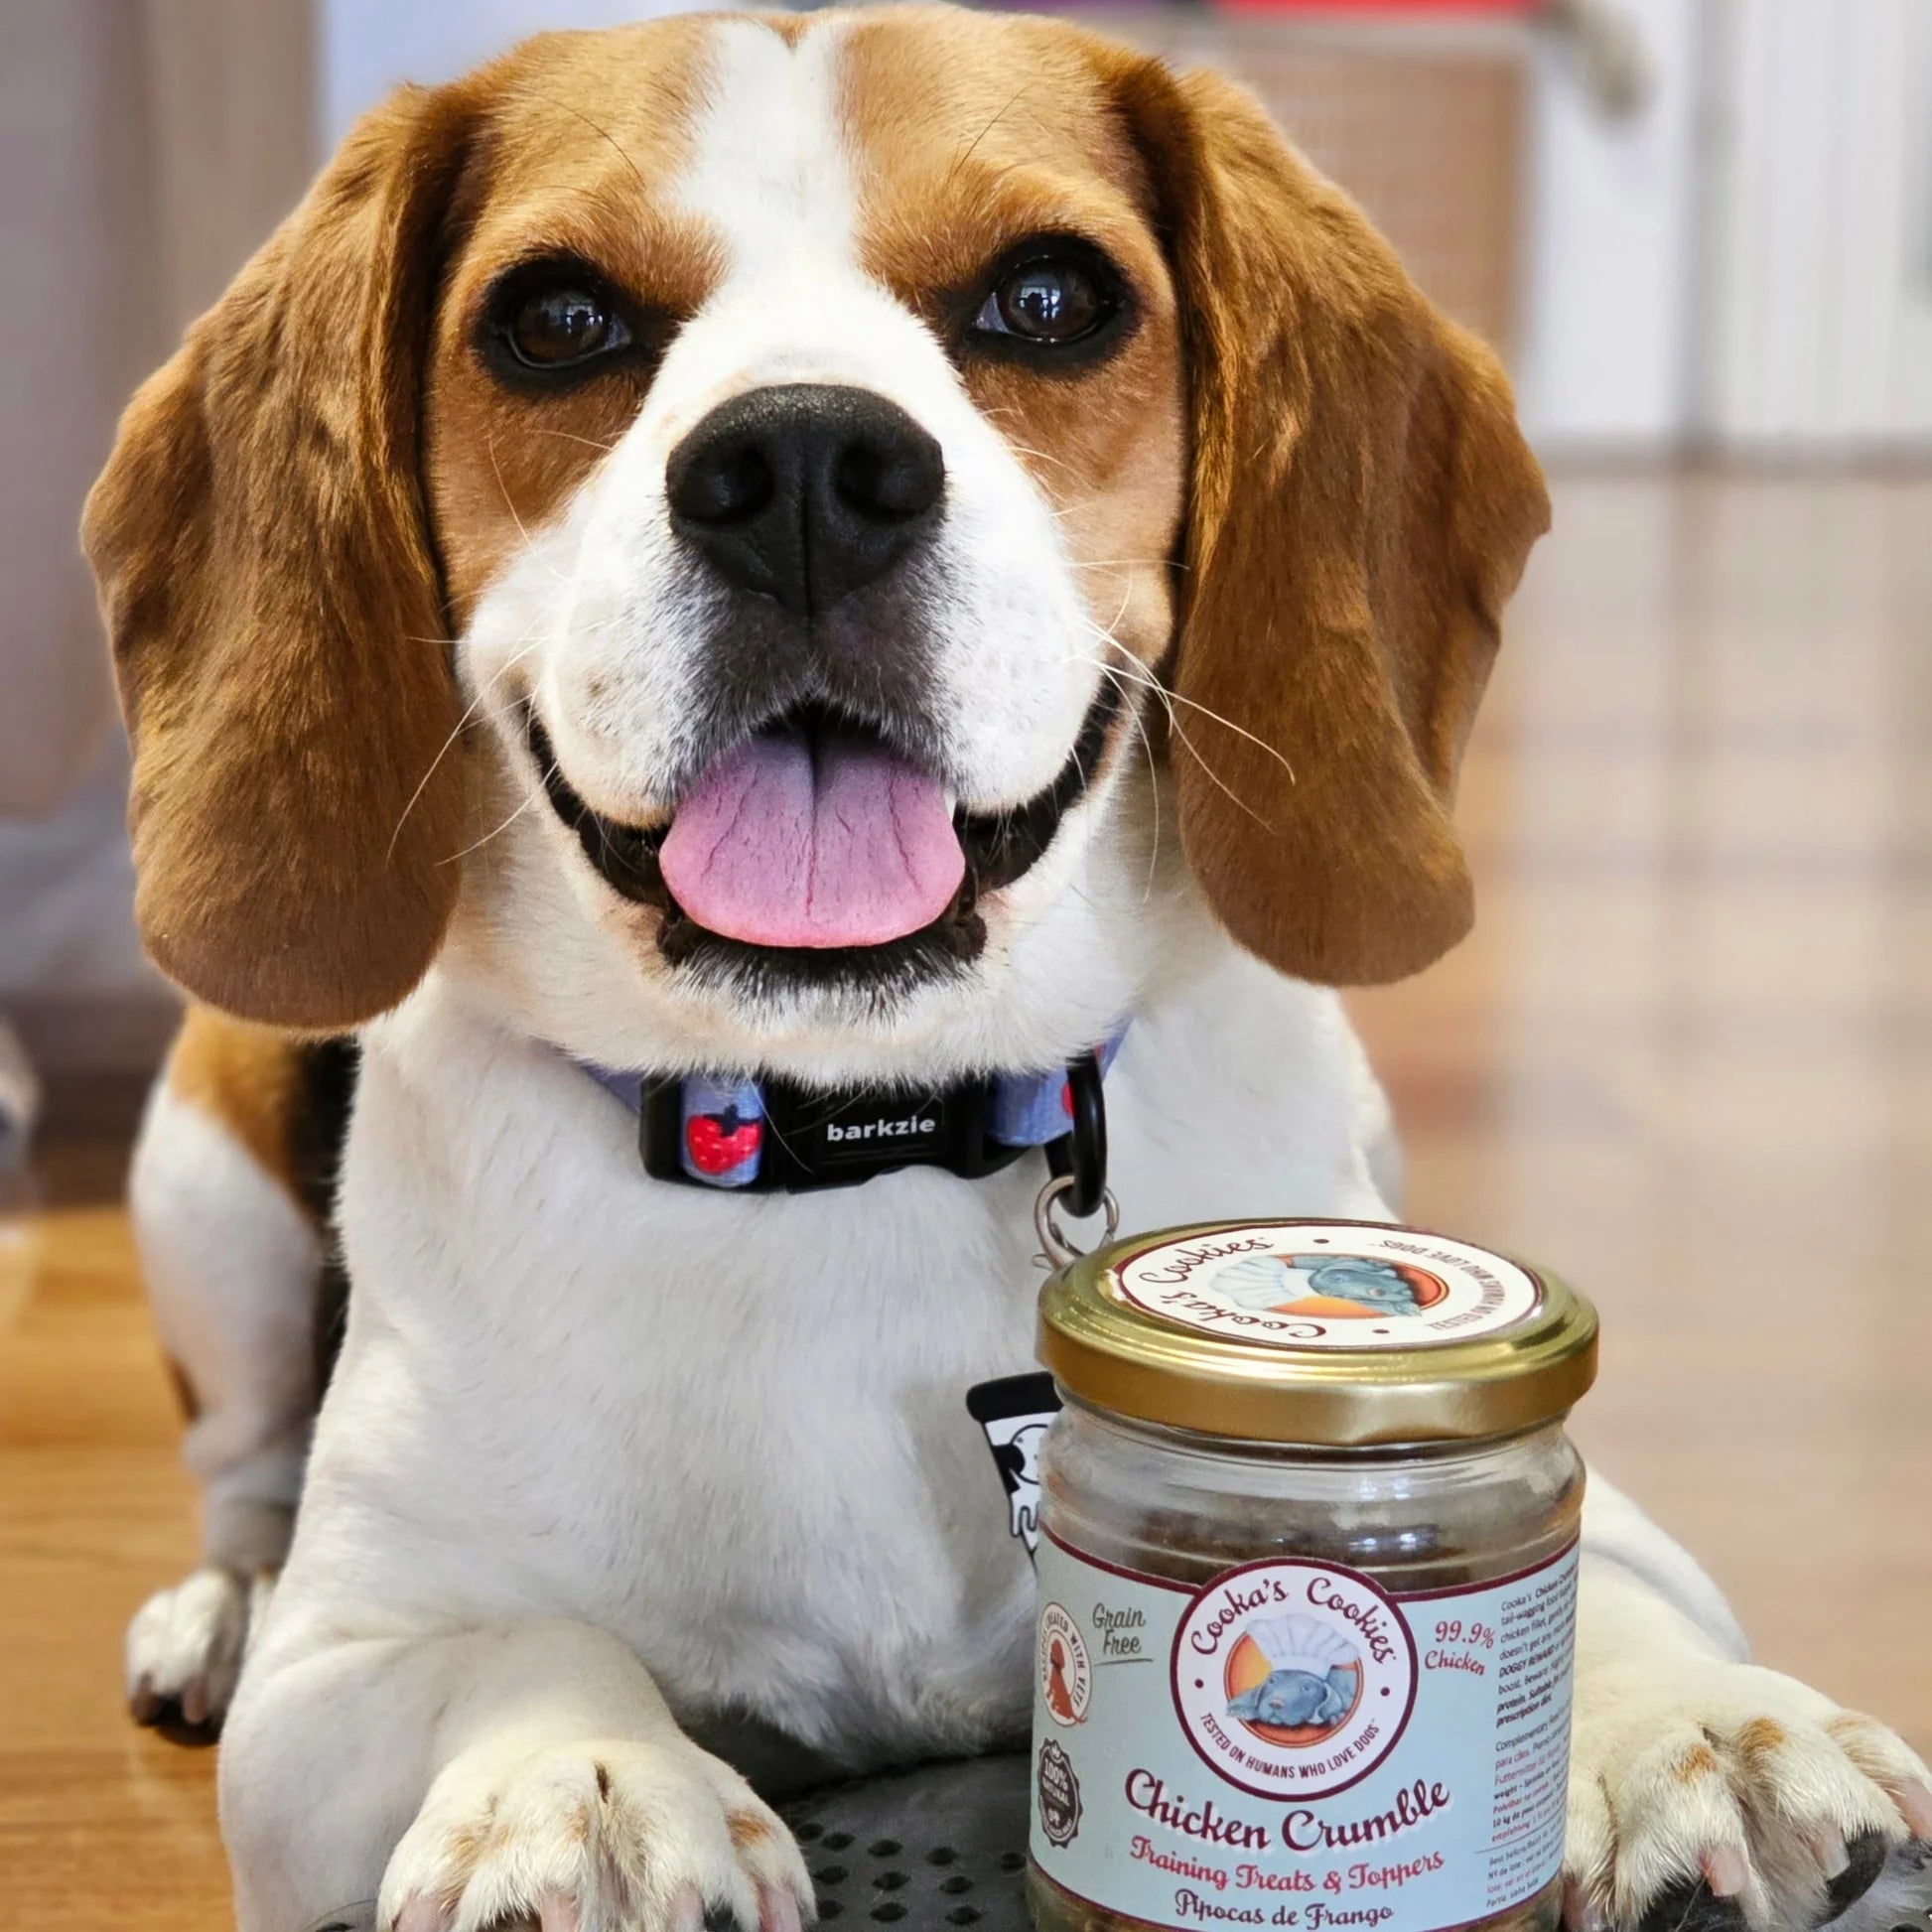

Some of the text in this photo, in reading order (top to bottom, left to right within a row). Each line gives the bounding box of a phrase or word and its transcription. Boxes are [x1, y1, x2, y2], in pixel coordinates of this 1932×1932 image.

[827, 1115, 936, 1142] barkzie
[1139, 1238, 1274, 1284] Cookies
[1092, 1602, 1147, 1630] Grain
[1191, 1577, 1395, 1665] Cooka's Cookies
[1435, 1619, 1496, 1649] 99.9%
[1103, 1629, 1143, 1657] Free
[1425, 1649, 1486, 1677] Chicken
[1200, 1712, 1381, 1779] TESTED ON HUMANS WHO LOVE DOGS
[1125, 1768, 1272, 1851] Chicken
[1281, 1778, 1450, 1852] Crumble
[1129, 1835, 1447, 1895] Training Treats & Toppers
[1174, 1888, 1394, 1931] Pipocas de Frango
